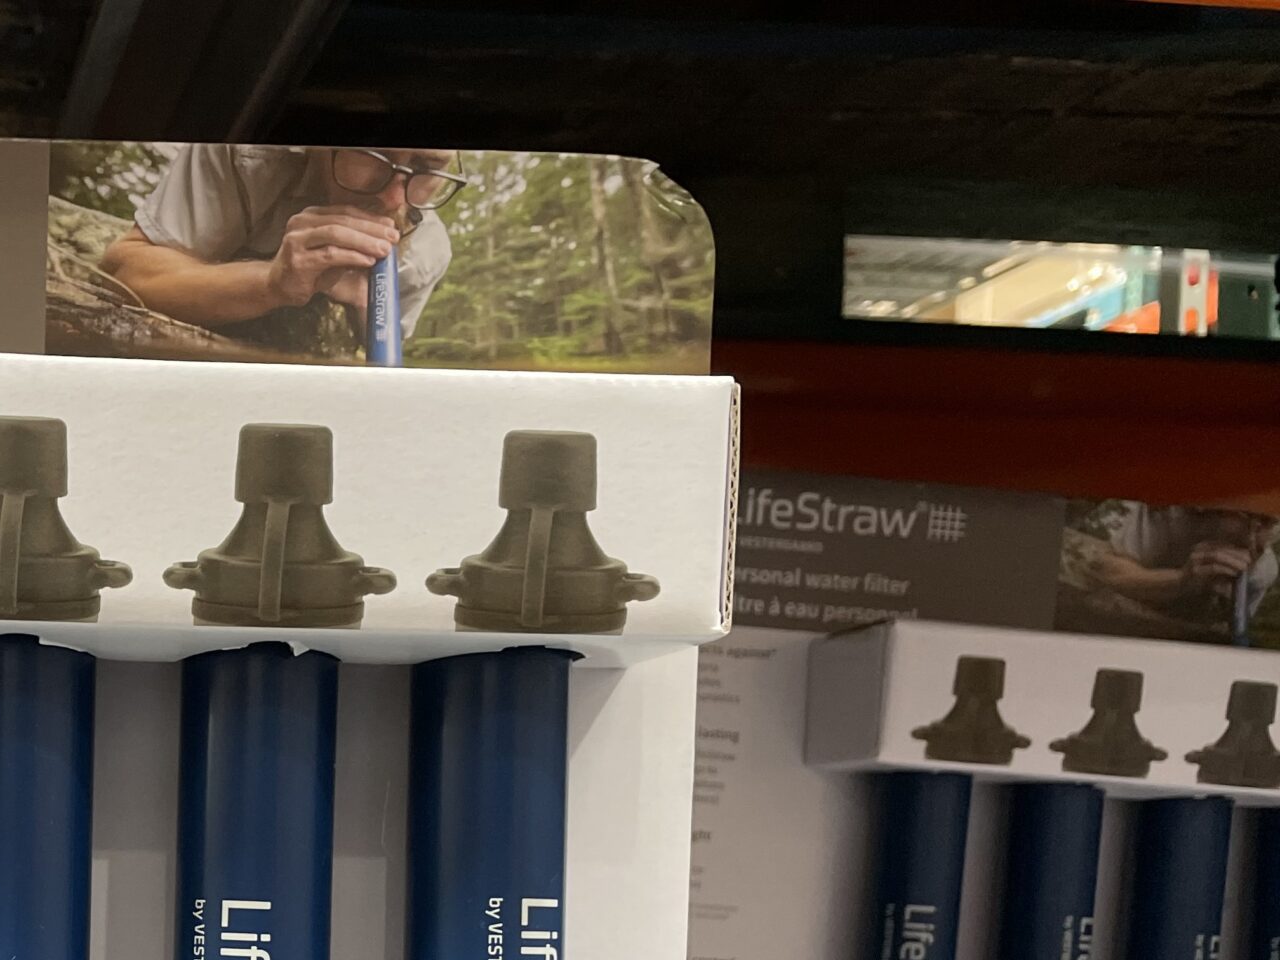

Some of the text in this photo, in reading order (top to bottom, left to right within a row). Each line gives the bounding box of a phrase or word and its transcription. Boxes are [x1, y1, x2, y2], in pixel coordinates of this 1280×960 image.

[738, 488, 918, 539] ifeStraw
[805, 571, 858, 592] water
[864, 571, 911, 596] filter
[785, 601, 818, 618] eau
[192, 898, 206, 920] by
[485, 897, 504, 919] by
